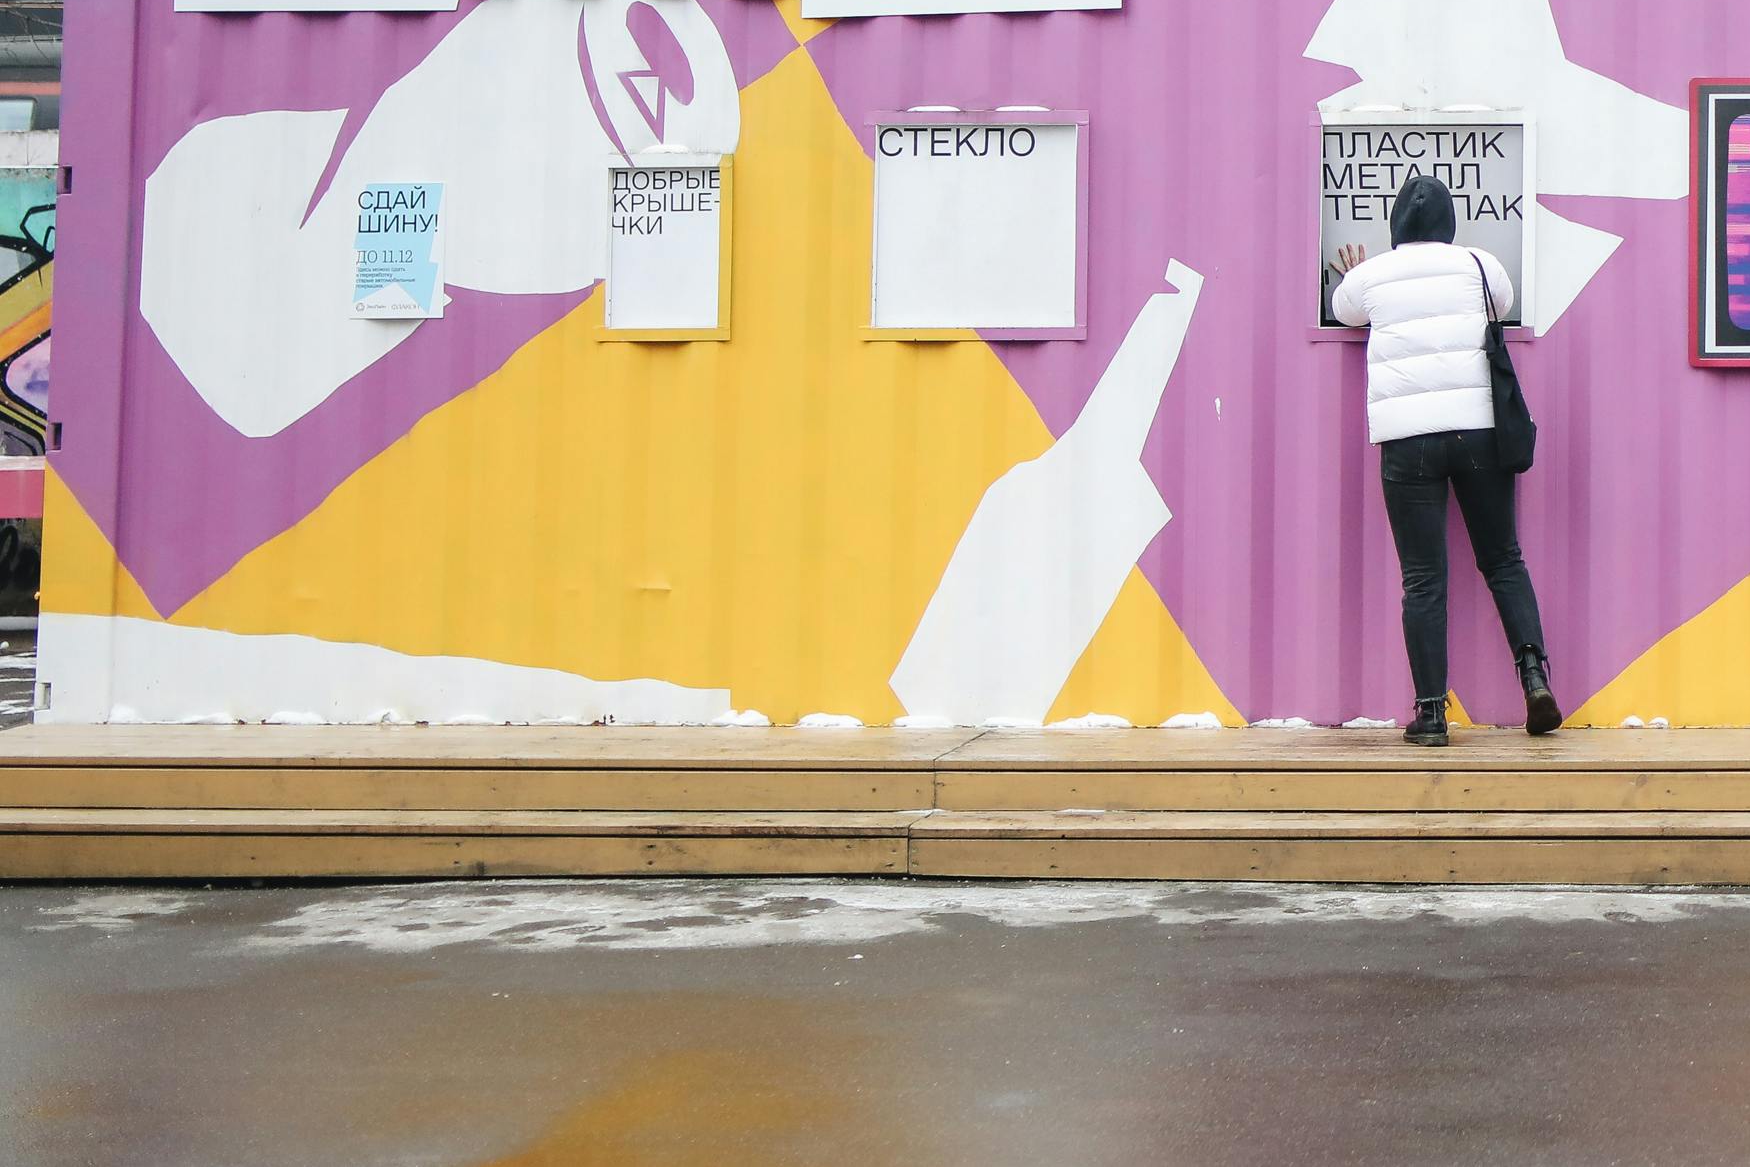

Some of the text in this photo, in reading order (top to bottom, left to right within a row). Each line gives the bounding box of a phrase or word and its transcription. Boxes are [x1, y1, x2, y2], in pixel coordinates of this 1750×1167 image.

[879, 127, 1036, 157] СТЕКЛО
[1323, 131, 1505, 159] ПЛАСТИК
[613, 170, 720, 194] ДОБРЫЕ
[358, 186, 426, 213] СДАЙ
[613, 193, 720, 213] КРЫШЕ-
[1324, 194, 1523, 221] ТЕТПАК
[358, 214, 439, 233] ШИНУ!
[612, 216, 663, 235] ЧКИ
[356, 249, 413, 265] ДО 11.12
